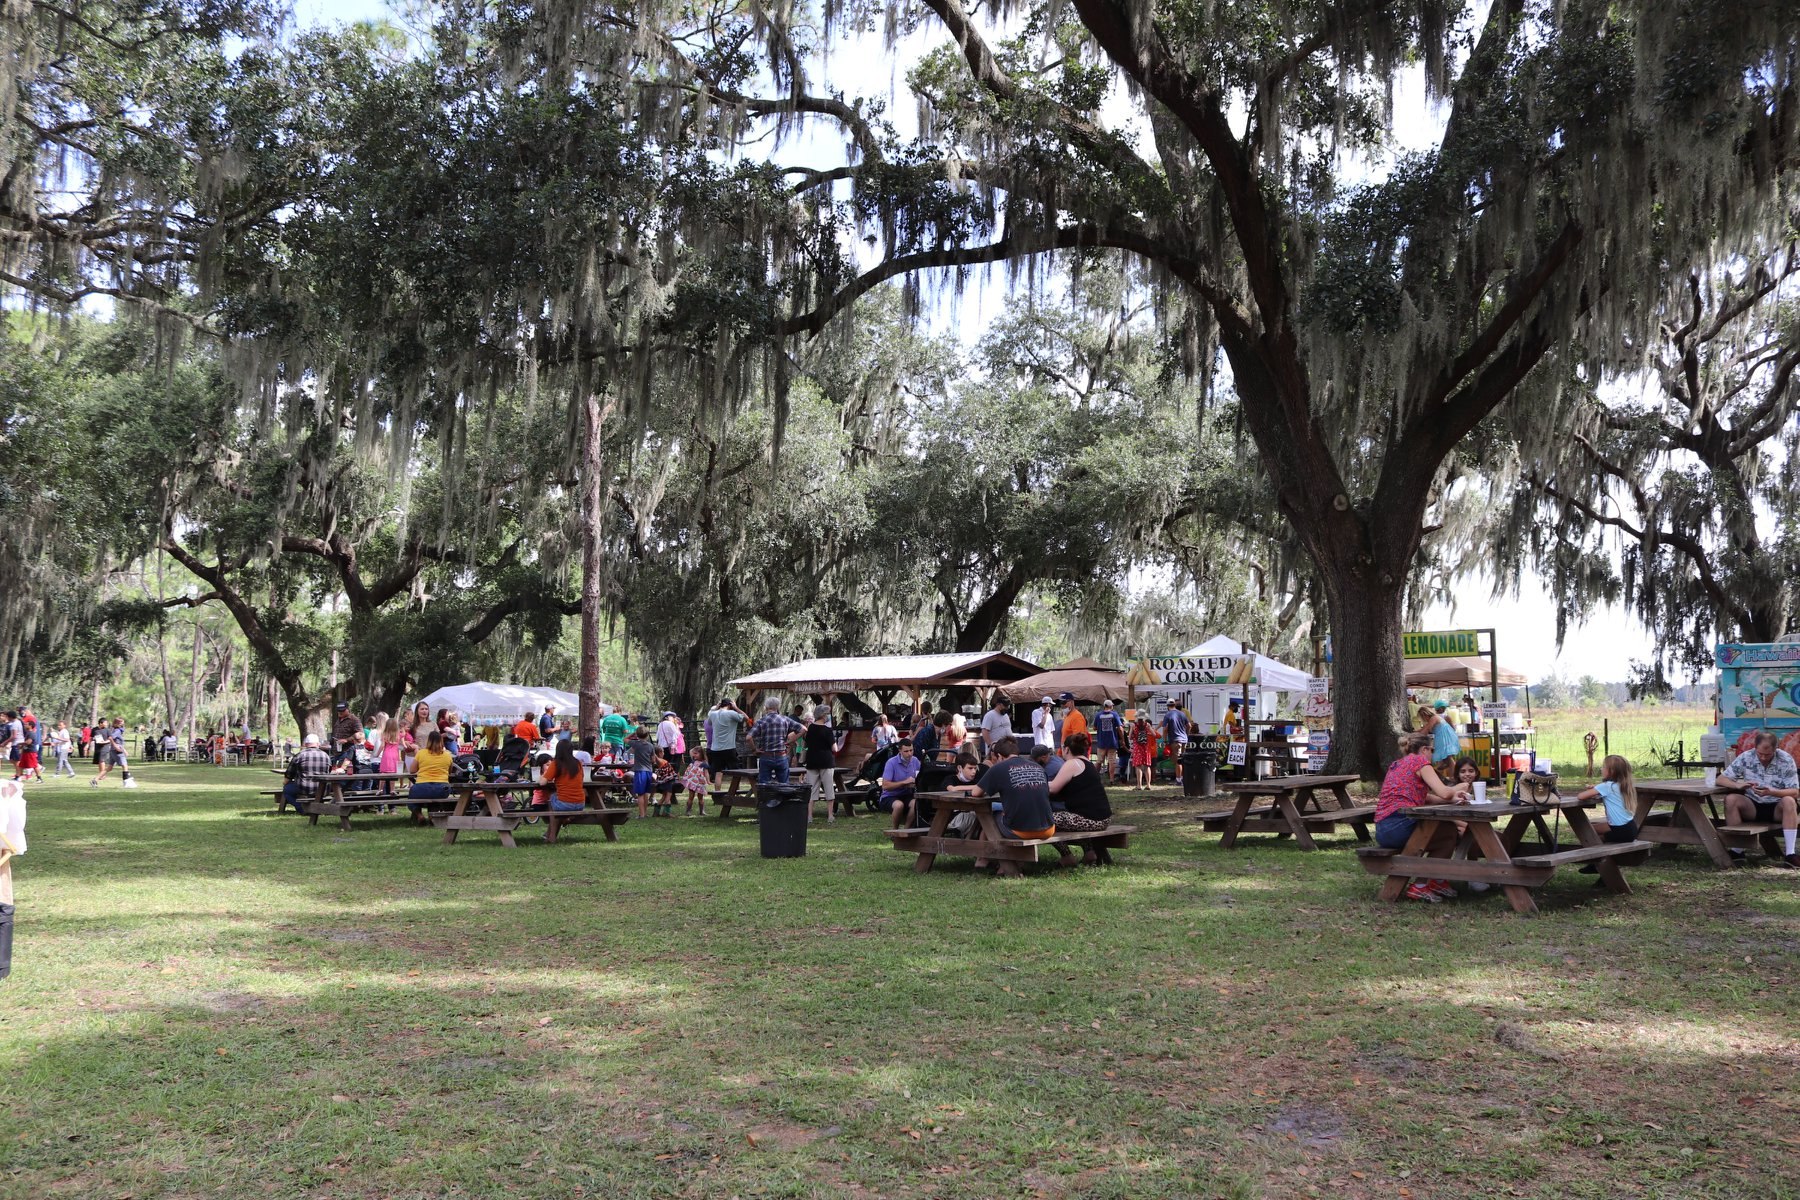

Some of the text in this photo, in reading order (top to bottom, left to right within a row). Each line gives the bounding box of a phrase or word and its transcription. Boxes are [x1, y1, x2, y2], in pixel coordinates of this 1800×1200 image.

[1403, 634, 1474, 654] LEMONADE
[1149, 657, 1232, 671] ROASTED
[1165, 671, 1216, 684] CORN
[794, 680, 856, 692] PIONEER KITCHEN
[1200, 741, 1229, 750] CORN
[1230, 744, 1245, 753] $3.00
[1229, 754, 1245, 763] EACH
